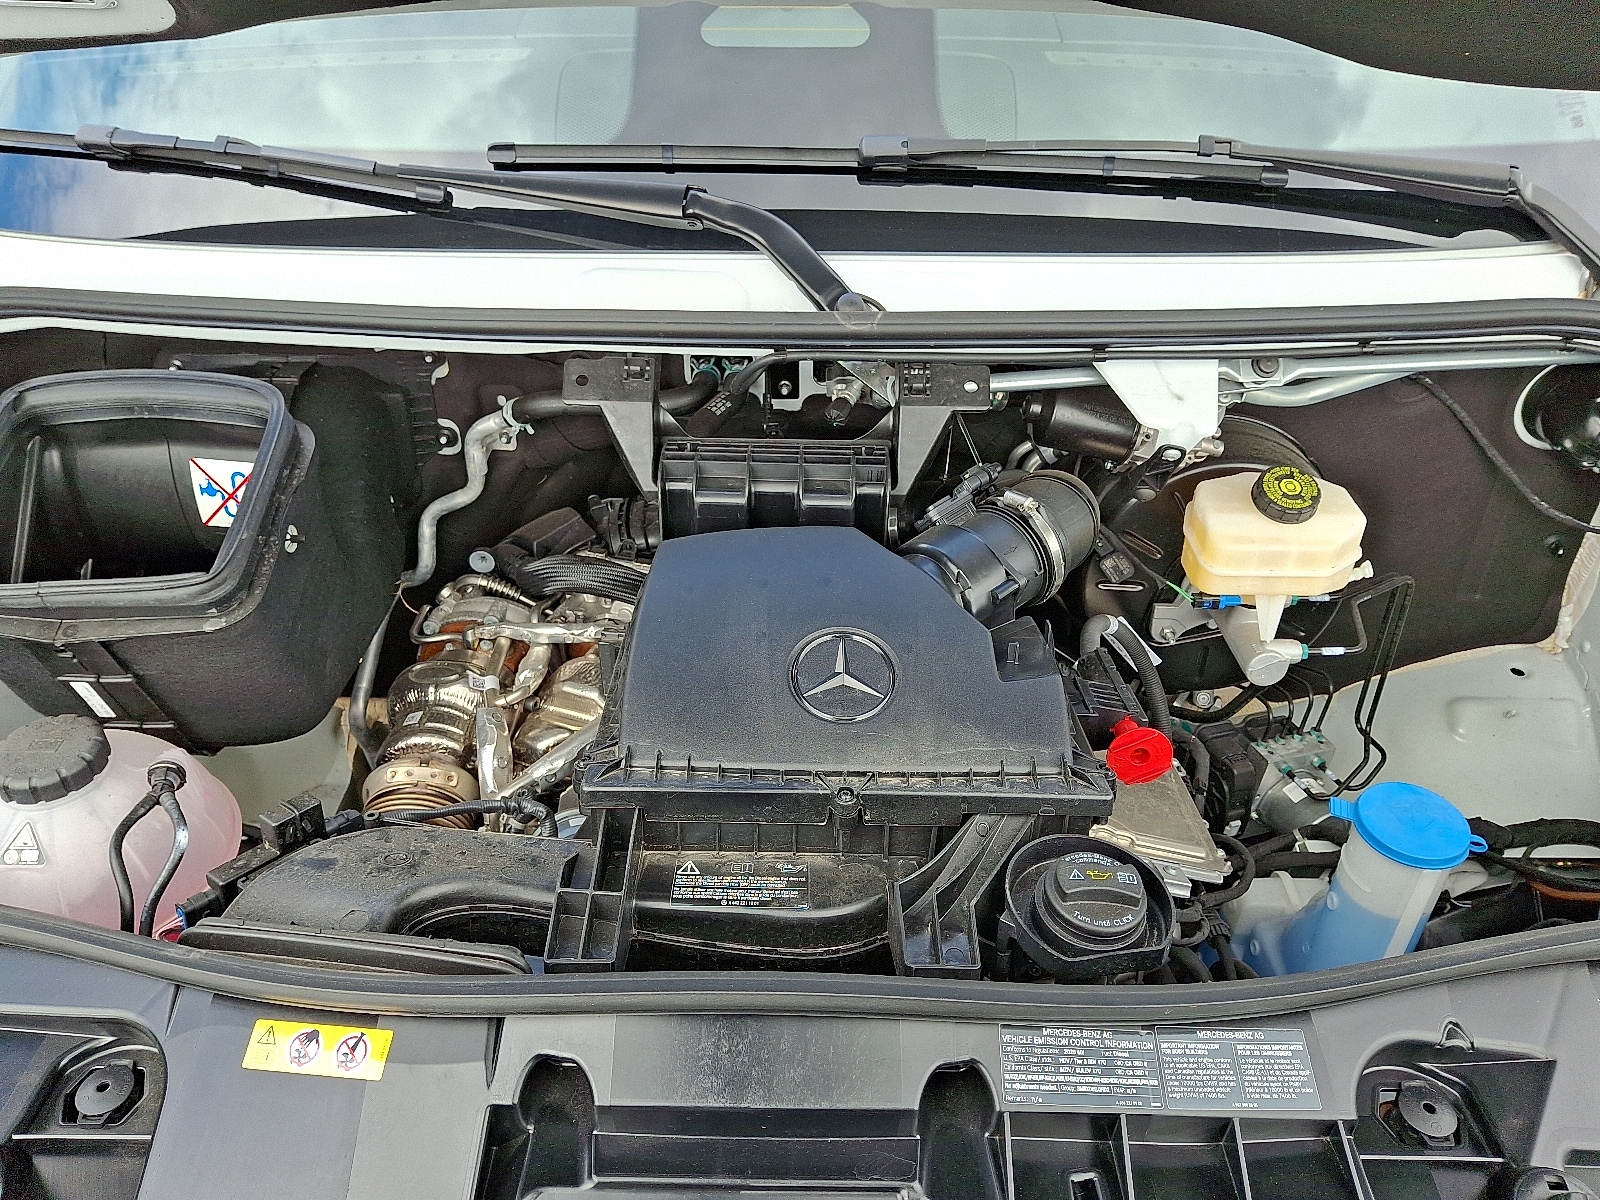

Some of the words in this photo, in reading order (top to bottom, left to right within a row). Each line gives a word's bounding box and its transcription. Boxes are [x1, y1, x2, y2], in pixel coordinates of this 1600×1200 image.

[1073, 911, 1091, 923] Turn
[1094, 918, 1110, 927] until
[1114, 914, 1134, 926] CLICK
[1042, 1028, 1101, 1038] MERCEDES-BENZ
[1103, 1031, 1112, 1039] AG
[1196, 1031, 1253, 1039] MERCEDES-BENZ
[1002, 1035, 1032, 1044] VEHICLE
[1034, 1037, 1069, 1046] EMISSION
[1070, 1038, 1103, 1047] CONTROL
[1105, 1040, 1153, 1050] INFORMATION
